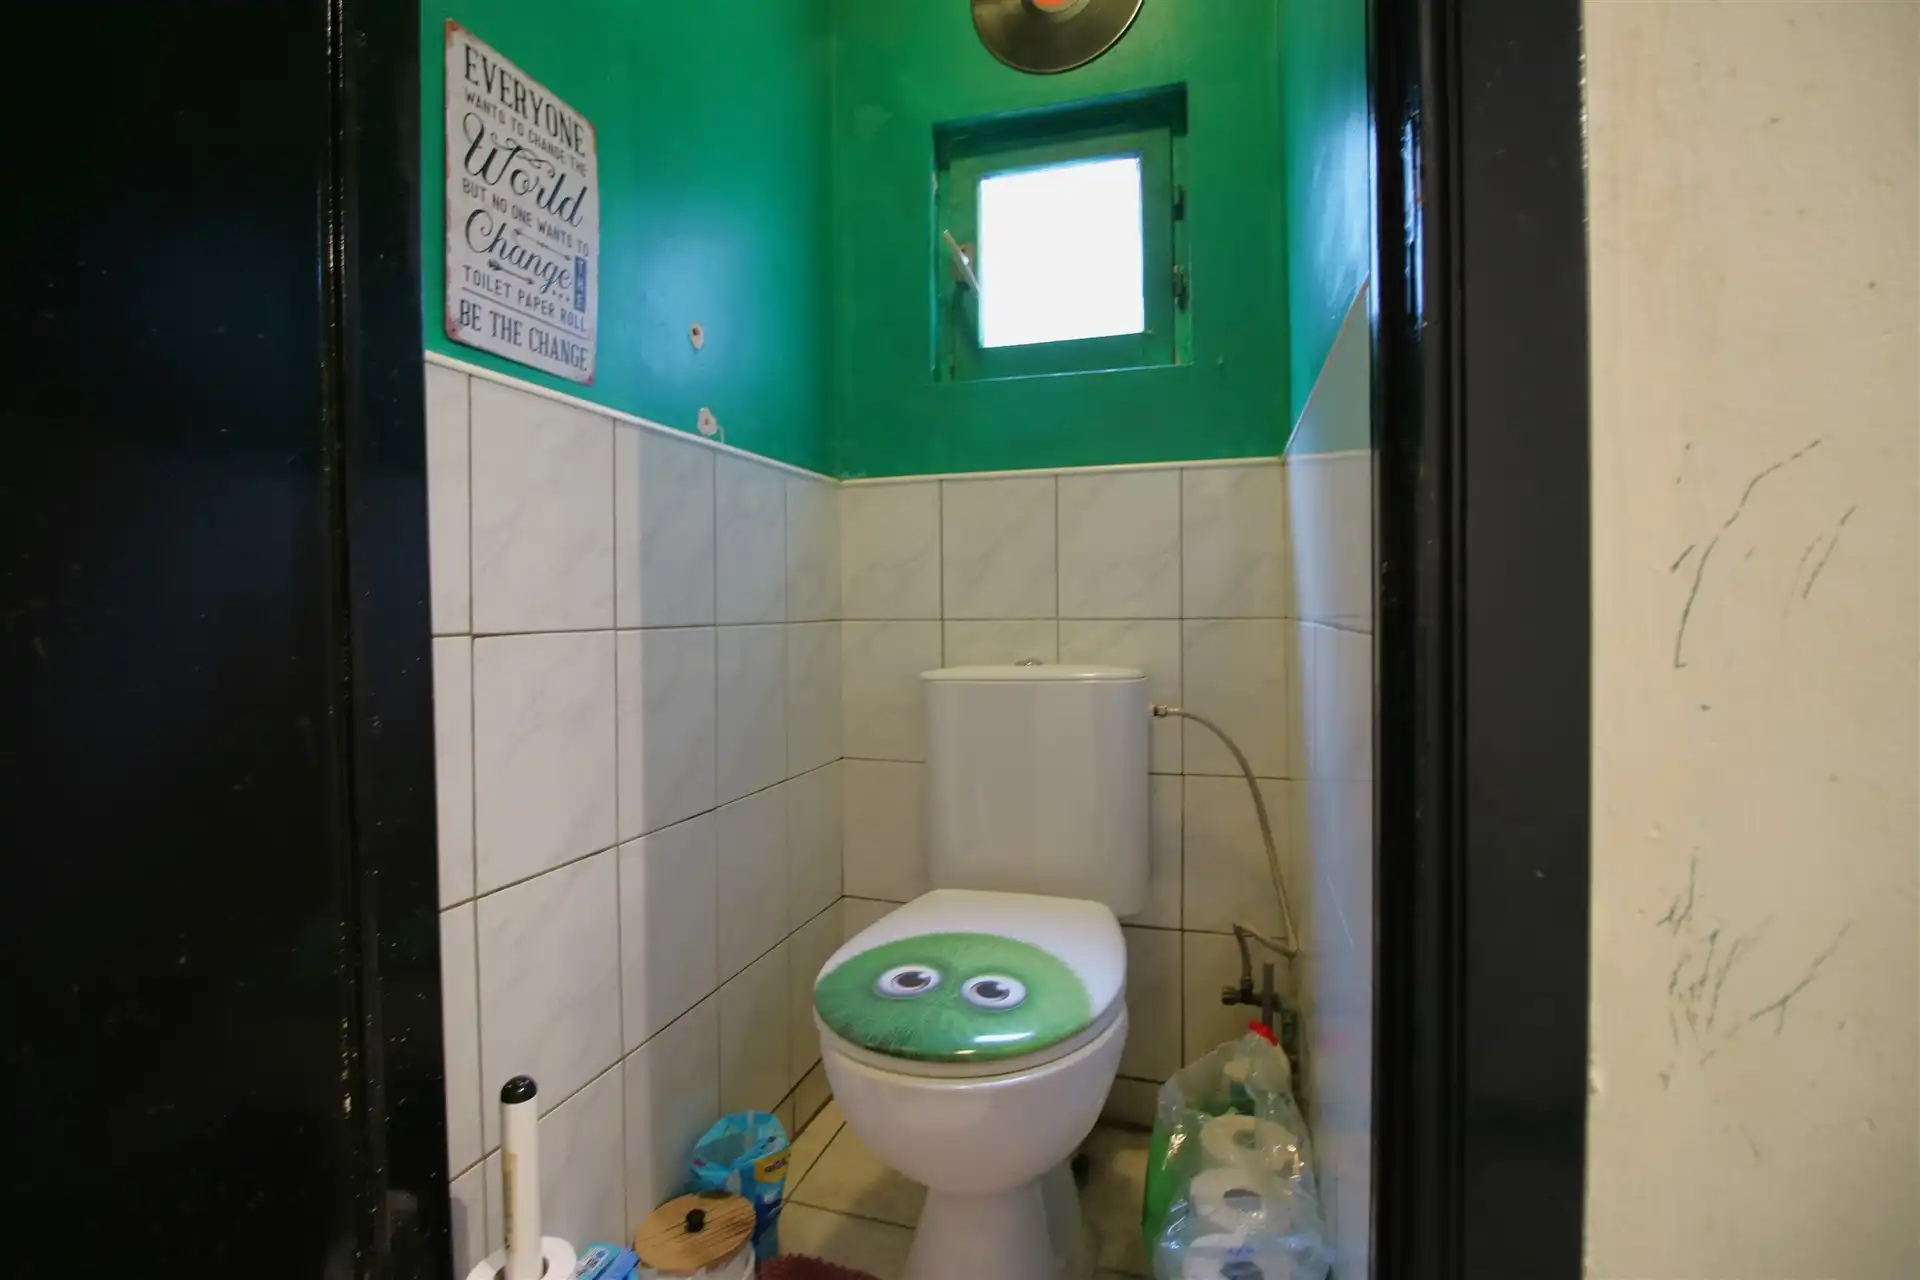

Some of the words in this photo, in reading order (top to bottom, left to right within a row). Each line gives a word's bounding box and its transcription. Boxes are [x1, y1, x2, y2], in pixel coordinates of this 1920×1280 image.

[464, 44, 586, 156] EVERYONE
[465, 87, 506, 125] WANTS
[511, 116, 525, 137] TO
[528, 129, 566, 165] CHANGE
[569, 154, 588, 178] THE
[463, 112, 588, 227] World
[462, 177, 488, 202] BUT
[492, 193, 508, 214] NO
[511, 204, 533, 228] ONE
[537, 217, 573, 248] WANTS
[578, 239, 590, 257] TO
[466, 208, 572, 294] Change
[459, 299, 483, 332] BE
[490, 310, 523, 347] THE
[528, 327, 588, 371] CHANGE
[462, 264, 512, 298] TOILET
[518, 288, 555, 319] PAPER
[560, 308, 587, 333] ROLL
